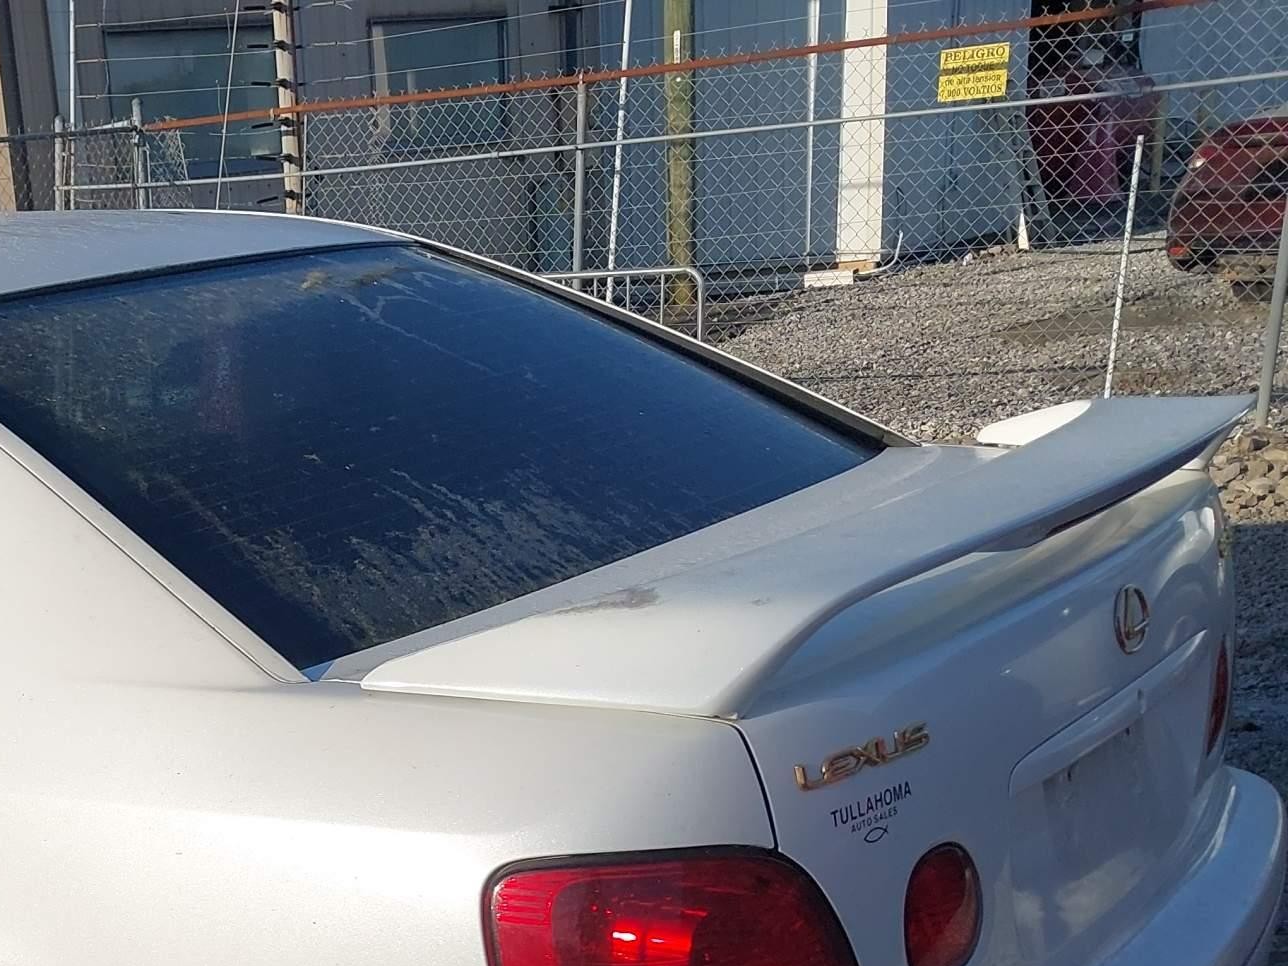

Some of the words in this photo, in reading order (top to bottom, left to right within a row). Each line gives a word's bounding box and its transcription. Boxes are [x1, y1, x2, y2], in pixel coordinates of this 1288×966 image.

[945, 46, 1006, 62] PELIGRO
[794, 721, 930, 791] LEXUS
[830, 781, 911, 827] TULLAHOMA
[851, 818, 873, 833] AUTO
[873, 806, 898, 823] SALES
